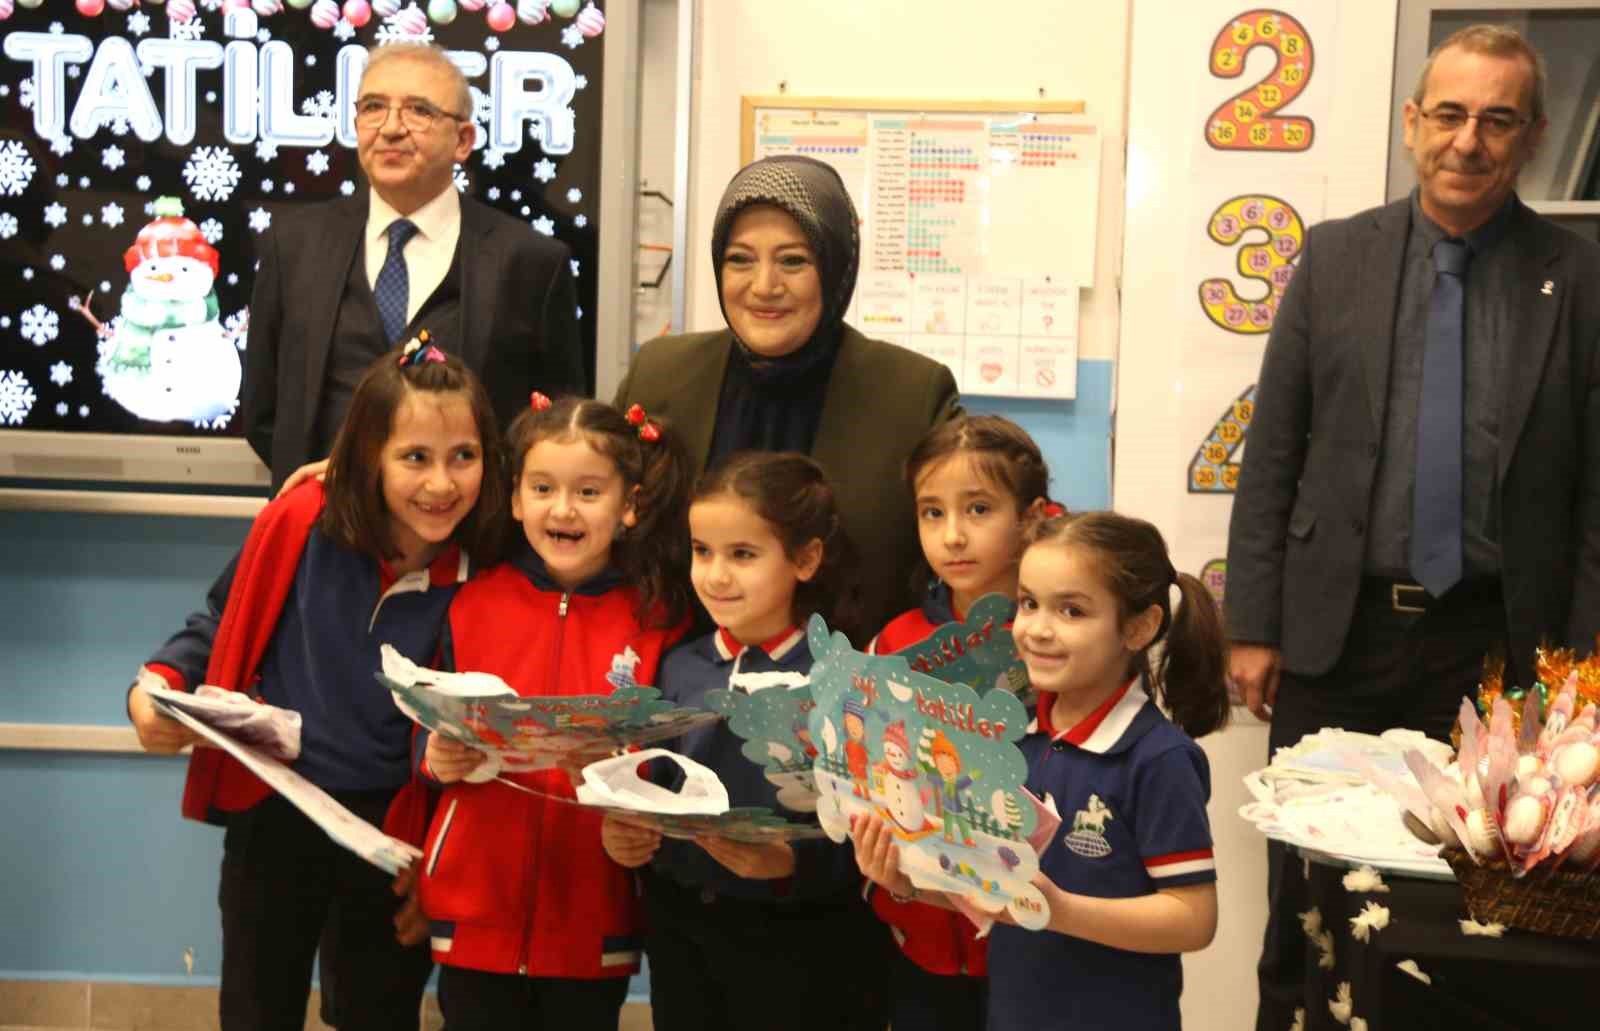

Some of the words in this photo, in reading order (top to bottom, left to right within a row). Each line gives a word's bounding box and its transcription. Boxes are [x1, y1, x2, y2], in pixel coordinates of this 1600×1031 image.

[1261, 21, 1273, 35] 6
[1286, 38, 1298, 54] 8
[1221, 52, 1233, 66] 2
[1205, 8, 1315, 152] 2
[1284, 69, 1300, 82] 10
[1263, 89, 1278, 102] 12
[1238, 105, 1253, 118] 14
[1217, 126, 1233, 139] 16
[1252, 127, 1267, 141] 18
[1287, 129, 1303, 141] 20
[1246, 205, 1257, 219] 6
[1274, 211, 1284, 226] 9
[1223, 218, 1234, 234] 3
[1278, 239, 1294, 252] 12
[1198, 194, 1304, 335] 3
[1253, 254, 1268, 268] 15
[1228, 308, 1244, 321] 27
[914, 686, 1007, 744] tatiller
